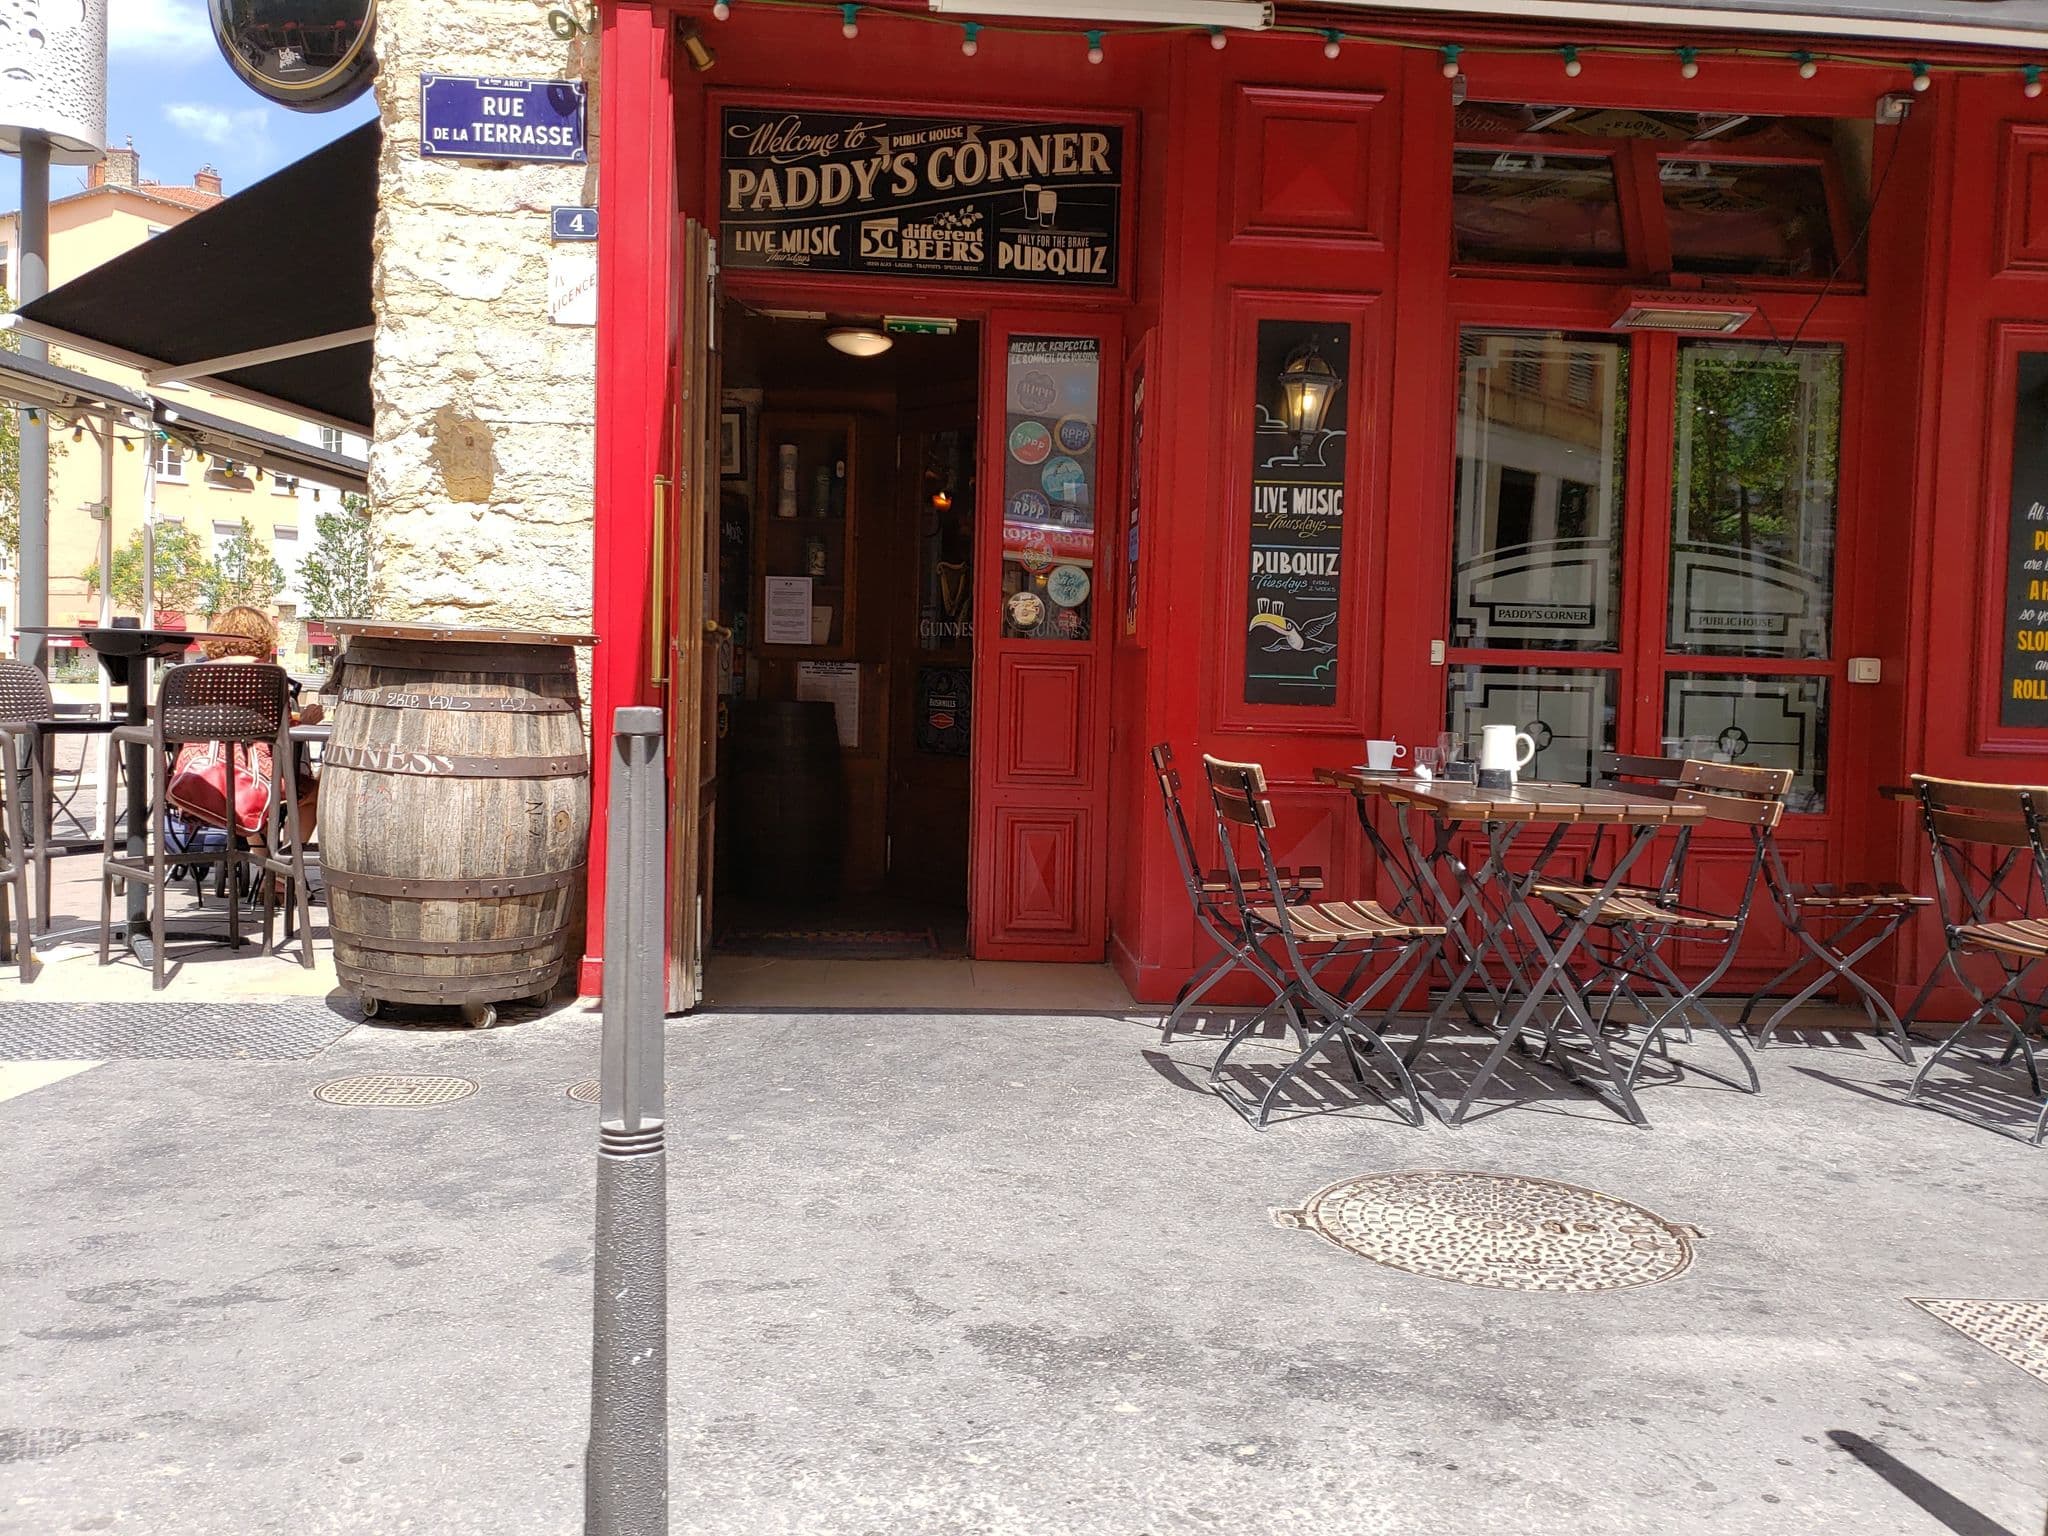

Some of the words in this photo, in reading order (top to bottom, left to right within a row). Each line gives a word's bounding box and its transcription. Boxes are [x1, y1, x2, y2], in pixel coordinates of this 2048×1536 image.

[483, 96, 524, 117] RUE
[433, 127, 449, 140] DE
[453, 128, 468, 141] LA
[472, 122, 573, 146] TERRASSE
[728, 115, 839, 163] Welcome
[844, 122, 887, 149] to
[892, 132, 926, 148] PUBLIC
[929, 127, 963, 142] HOUSE
[728, 153, 917, 212] PADDY'S
[927, 132, 1113, 191] CORNER
[569, 213, 585, 232] 4
[735, 230, 777, 254] LIVE
[782, 225, 841, 256] MUSIC
[862, 227, 900, 254] 50
[902, 223, 984, 242] different
[1018, 234, 1035, 246] ONLY
[1037, 235, 1050, 247] FOR
[1053, 236, 1065, 248] THE
[1068, 236, 1090, 248] BRAVE
[901, 239, 984, 263] BEERS
[998, 241, 1107, 275] PUBQUIZ
[553, 273, 596, 314] LICENCE
[1010, 342, 1035, 353] MERCI
[1014, 500, 1044, 519] RPPP
[1255, 486, 1288, 513] LIVE
[1293, 487, 1343, 516] MUSIC
[1265, 512, 1327, 538] Thursdays
[1252, 551, 1339, 576] PUBQUIZ
[2024, 559, 2043, 571] are
[1251, 574, 1308, 594] Tuesdays
[1498, 609, 1542, 620] PADDY'S
[1544, 611, 1587, 621] CORNER
[1698, 616, 1737, 627] PUBLIC
[1738, 617, 1774, 628] HOUSE
[2019, 609, 2036, 621] so
[2013, 678, 2048, 700] ROLL
